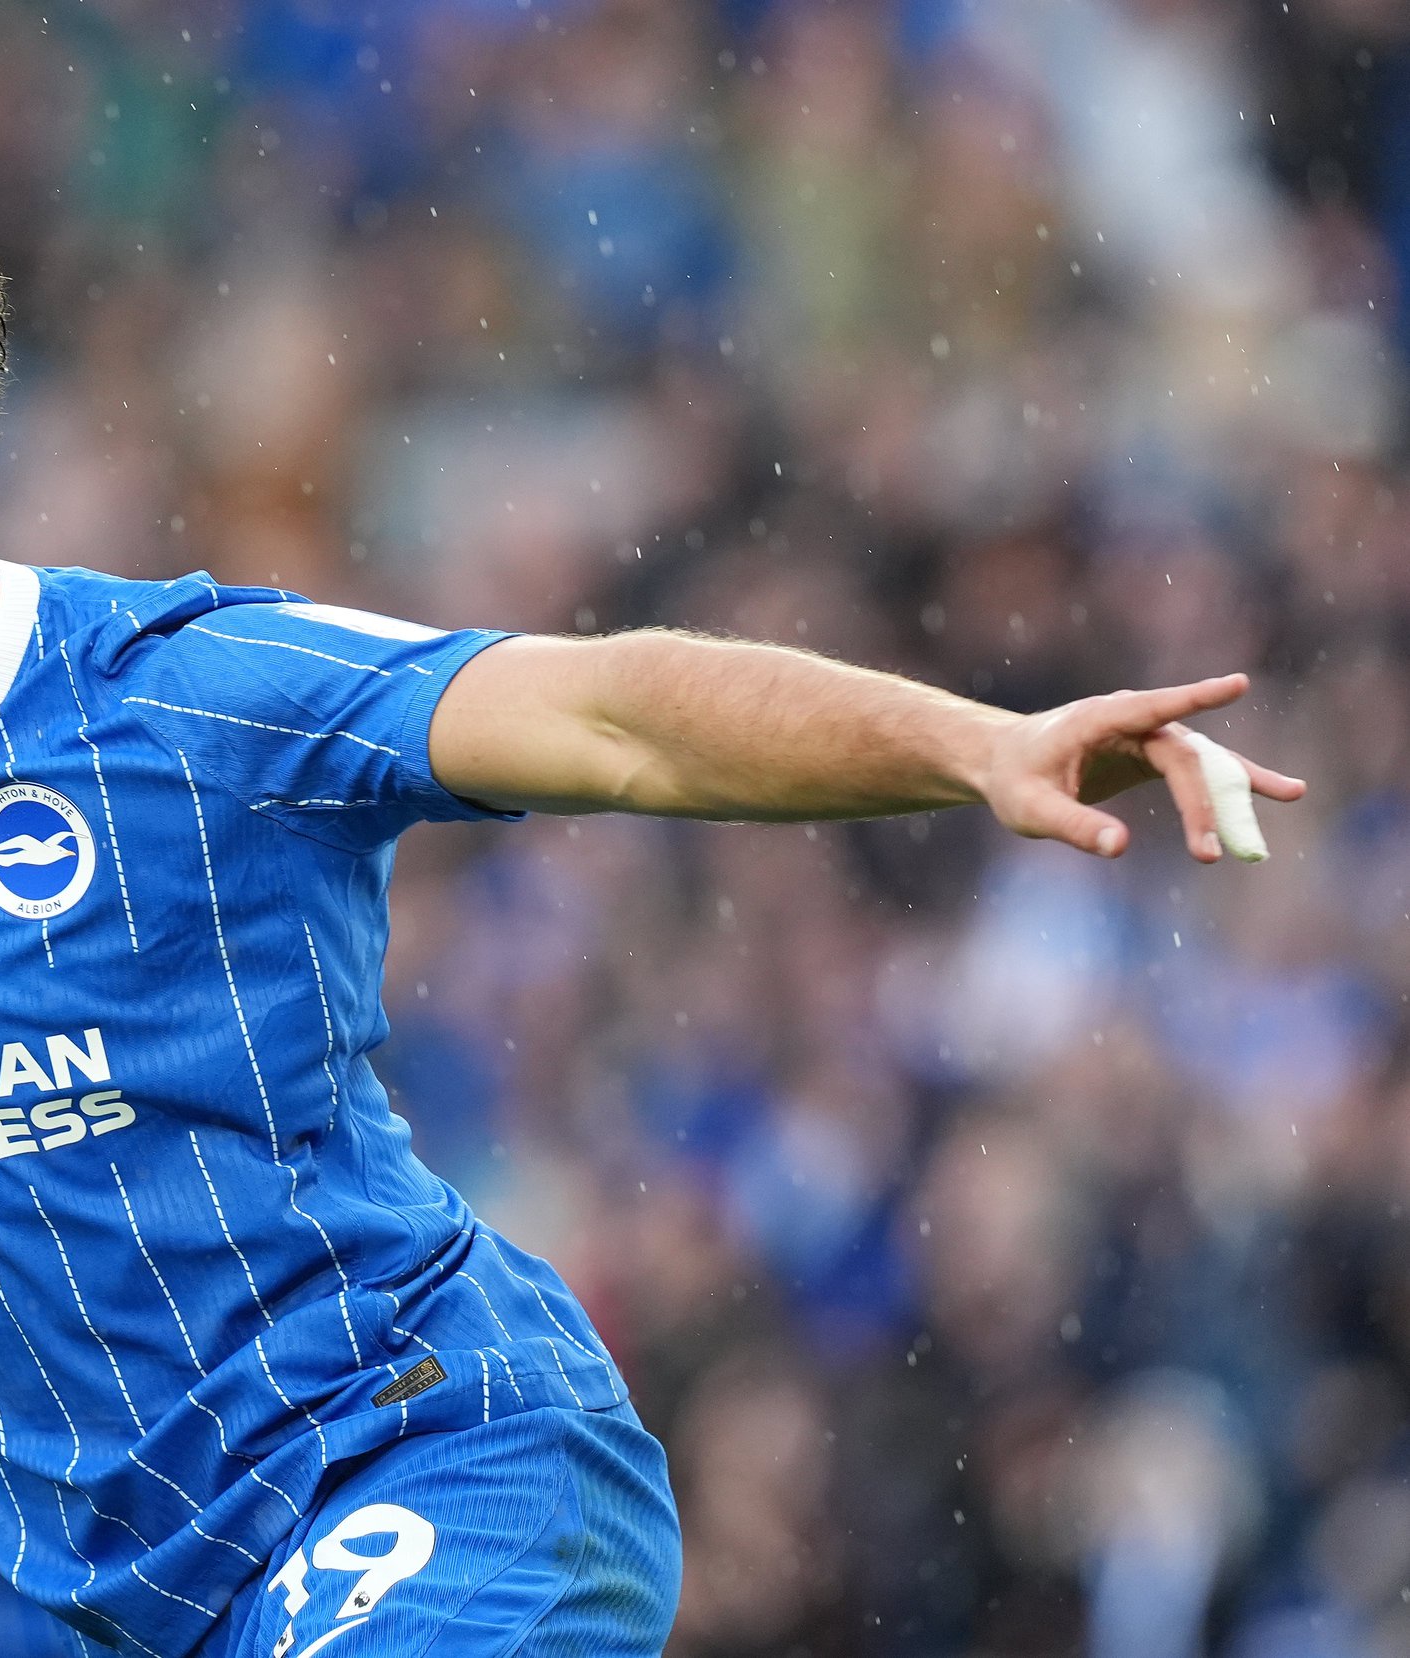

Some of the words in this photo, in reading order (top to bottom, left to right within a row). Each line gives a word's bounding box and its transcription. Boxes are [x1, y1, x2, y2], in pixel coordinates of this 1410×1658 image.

[31, 789, 39, 798] &
[43, 793, 74, 818] HOVE
[17, 899, 62, 914] ALBION
